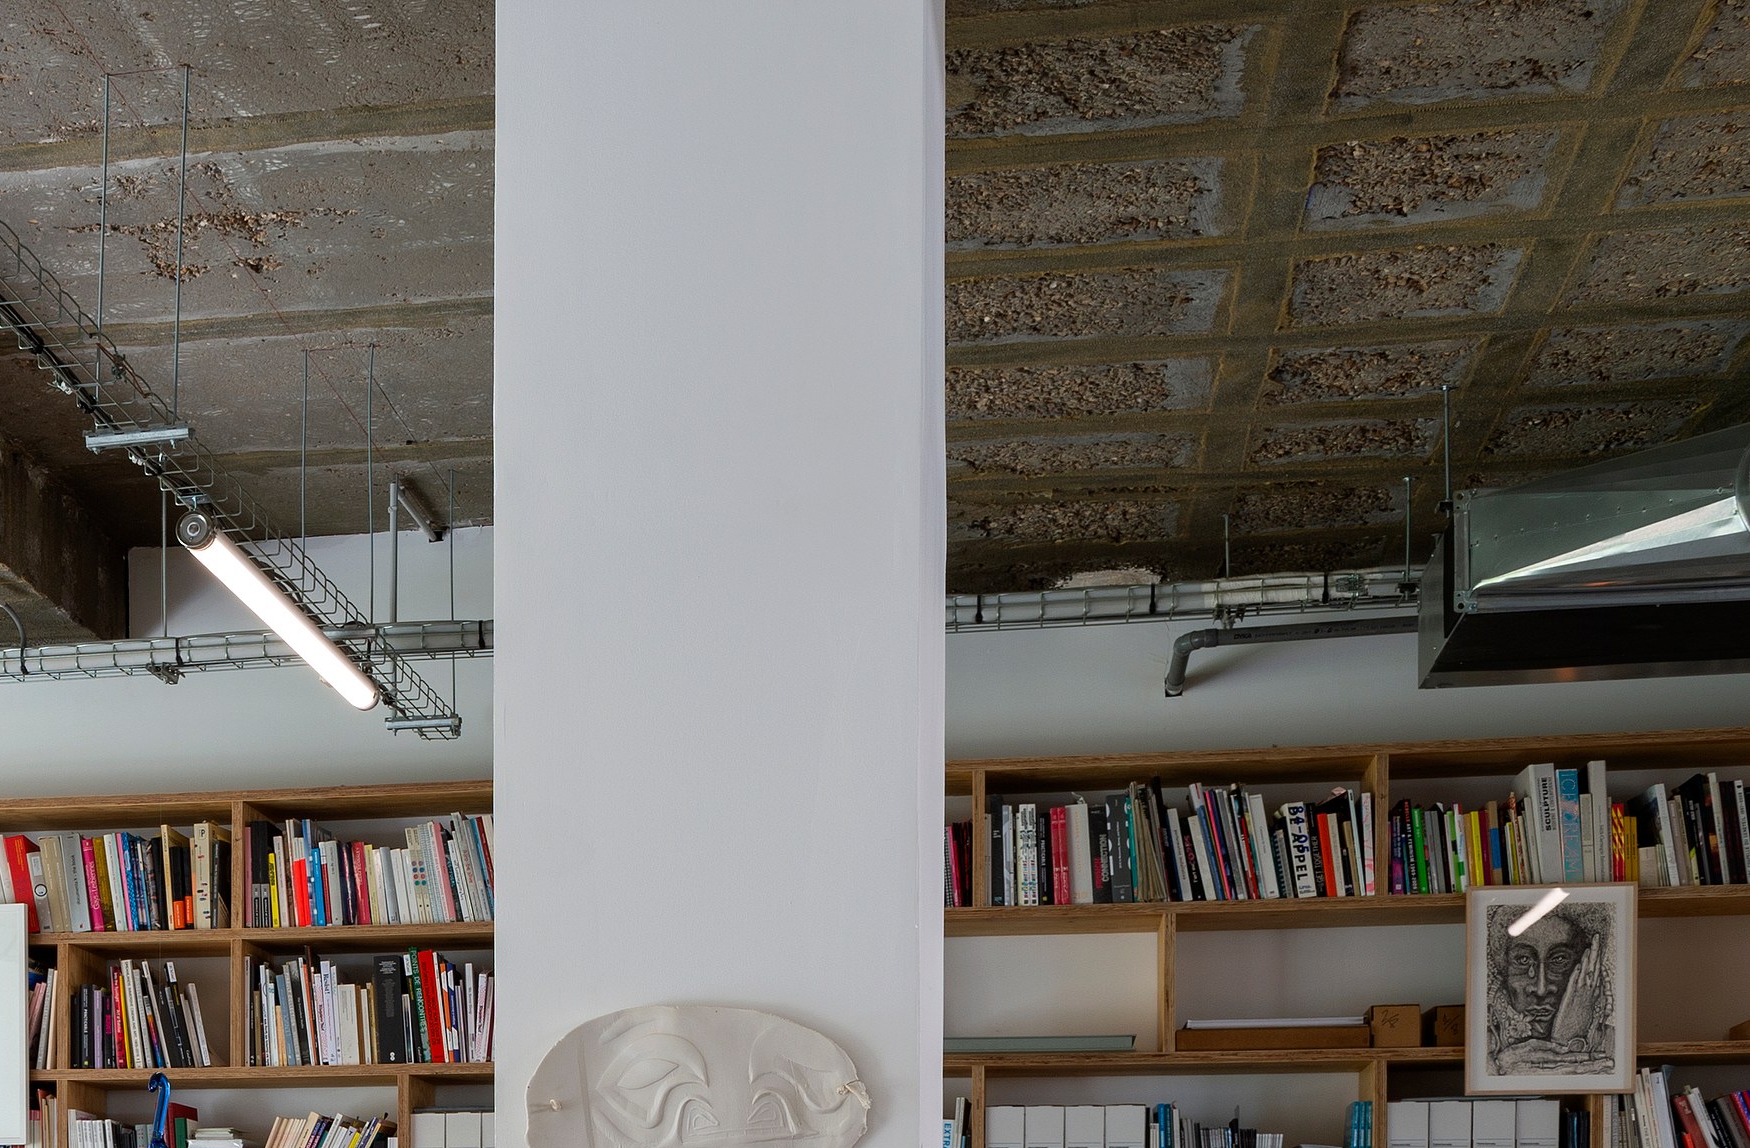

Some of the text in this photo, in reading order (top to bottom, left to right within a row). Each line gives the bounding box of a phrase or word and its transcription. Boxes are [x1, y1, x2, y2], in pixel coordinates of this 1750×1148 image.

[1542, 777, 1552, 831] SCULPTURE
[1561, 774, 1576, 800] ICE
[1295, 806, 1309, 853] 84-05
[1099, 834, 1109, 882] CONNECTION
[1291, 832, 1308, 881] APPEL
